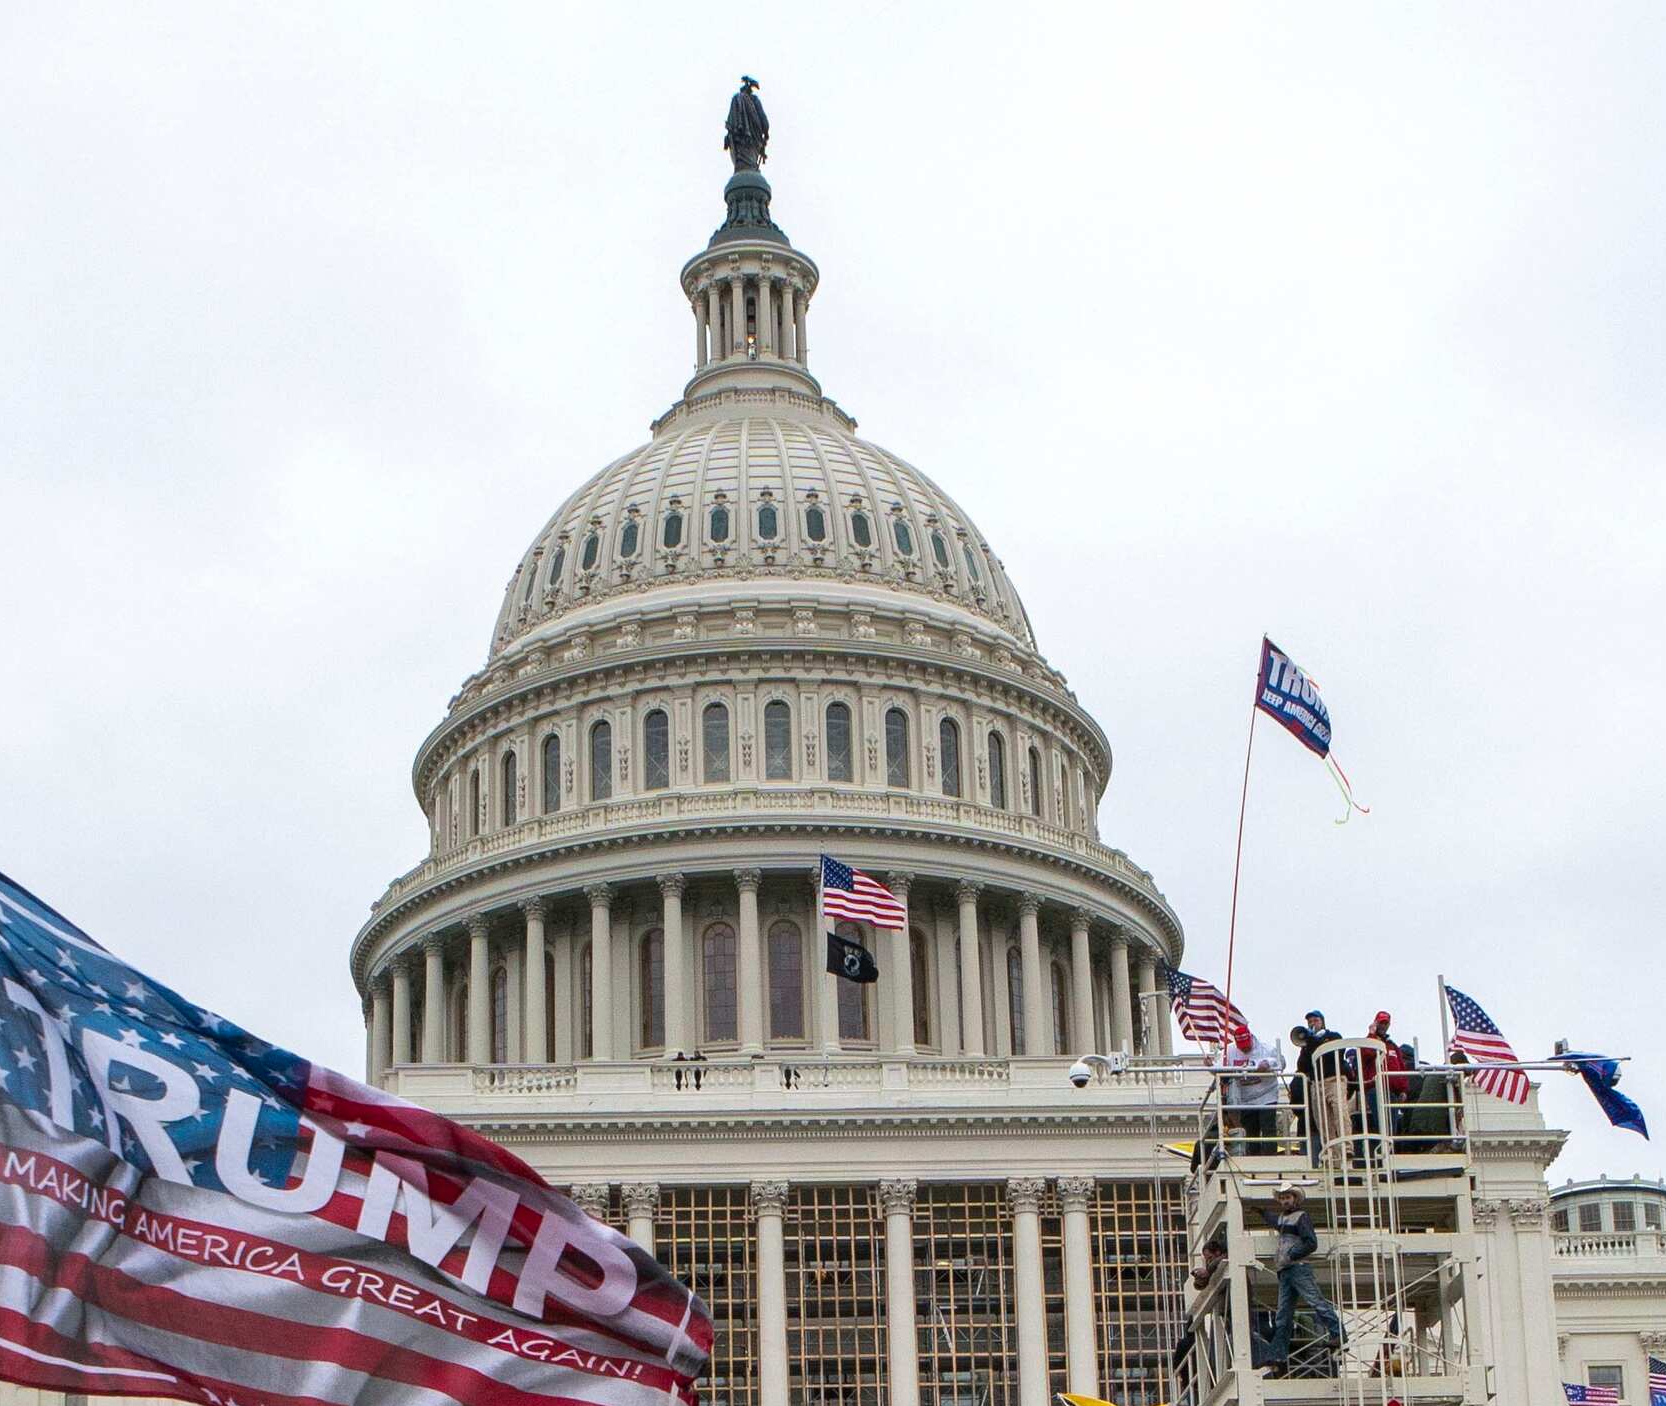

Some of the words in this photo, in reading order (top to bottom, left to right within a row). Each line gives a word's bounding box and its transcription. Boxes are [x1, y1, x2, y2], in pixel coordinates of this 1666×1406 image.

[4, 976, 640, 1321] TRUMP
[4, 1151, 126, 1226] MAKING
[134, 1209, 307, 1283] AMERICA
[323, 1264, 479, 1335] GREAT
[489, 1326, 645, 1381] AGAIN!
